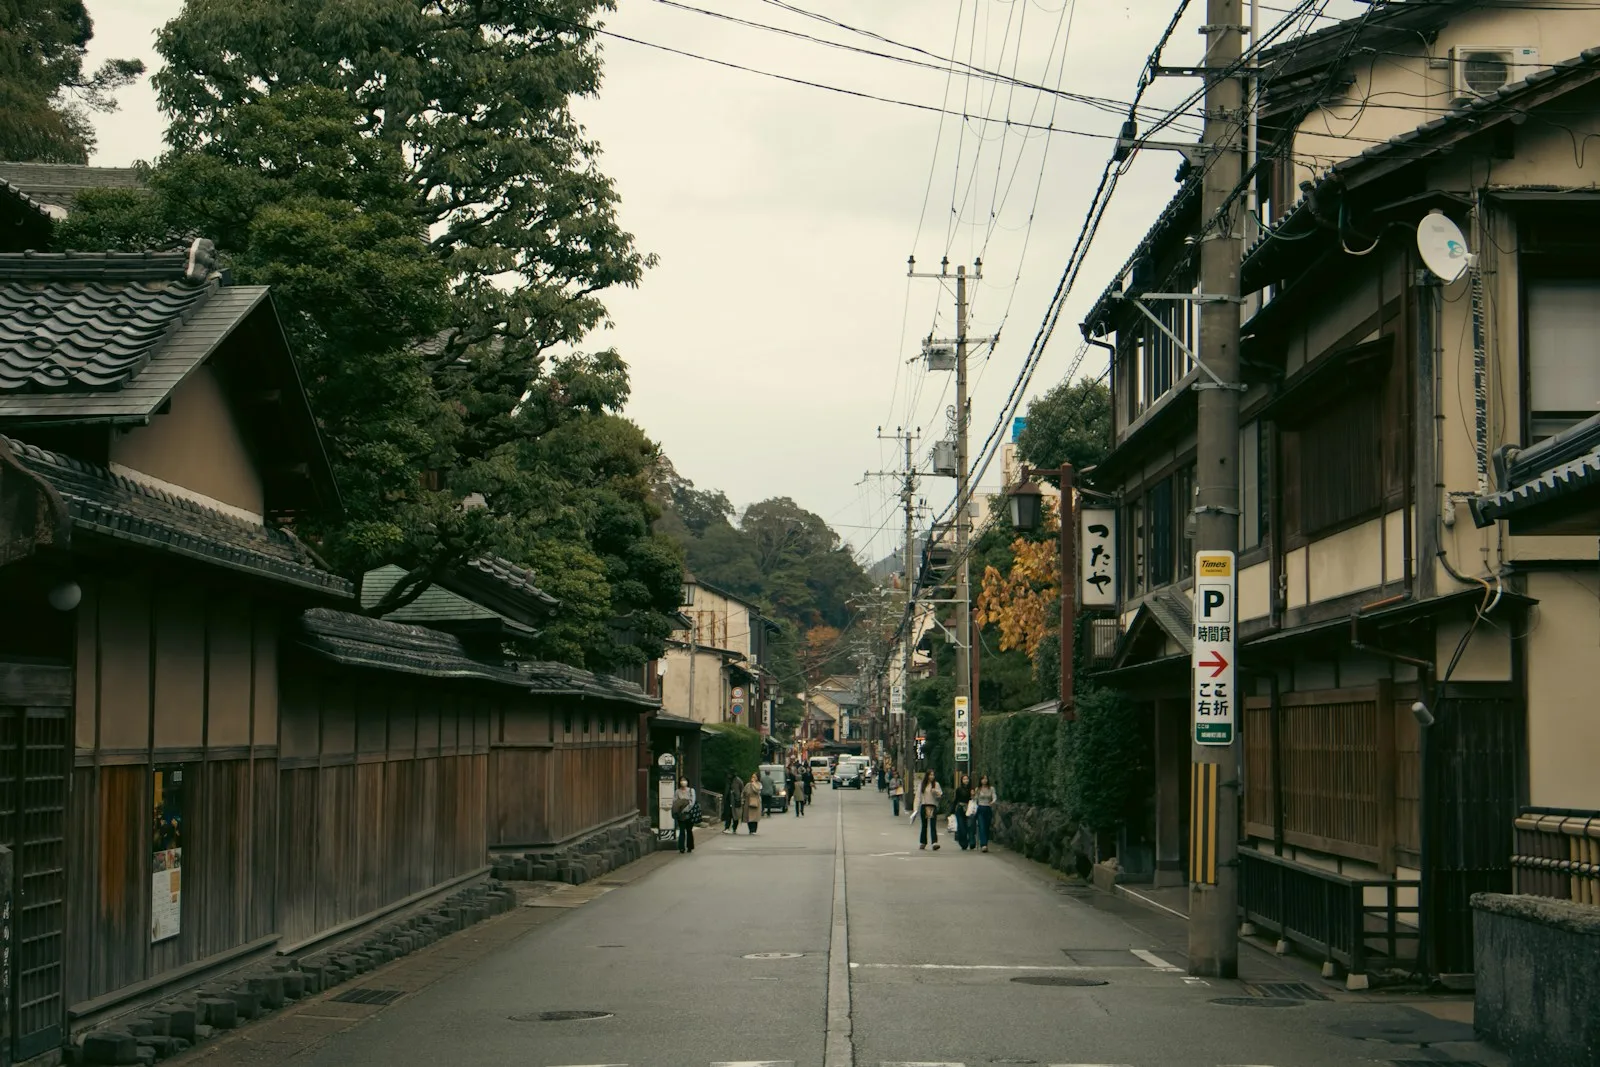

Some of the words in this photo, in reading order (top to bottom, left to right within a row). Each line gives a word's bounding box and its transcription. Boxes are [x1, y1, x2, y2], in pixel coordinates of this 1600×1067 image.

[1087, 524, 1111, 595] つたや
[1202, 560, 1227, 568] Times
[1204, 590, 1224, 617] P
[1198, 626, 1231, 642] 時間貸
[1199, 683, 1227, 697] ここ
[957, 709, 965, 719] P
[1198, 700, 1228, 716] 右折
